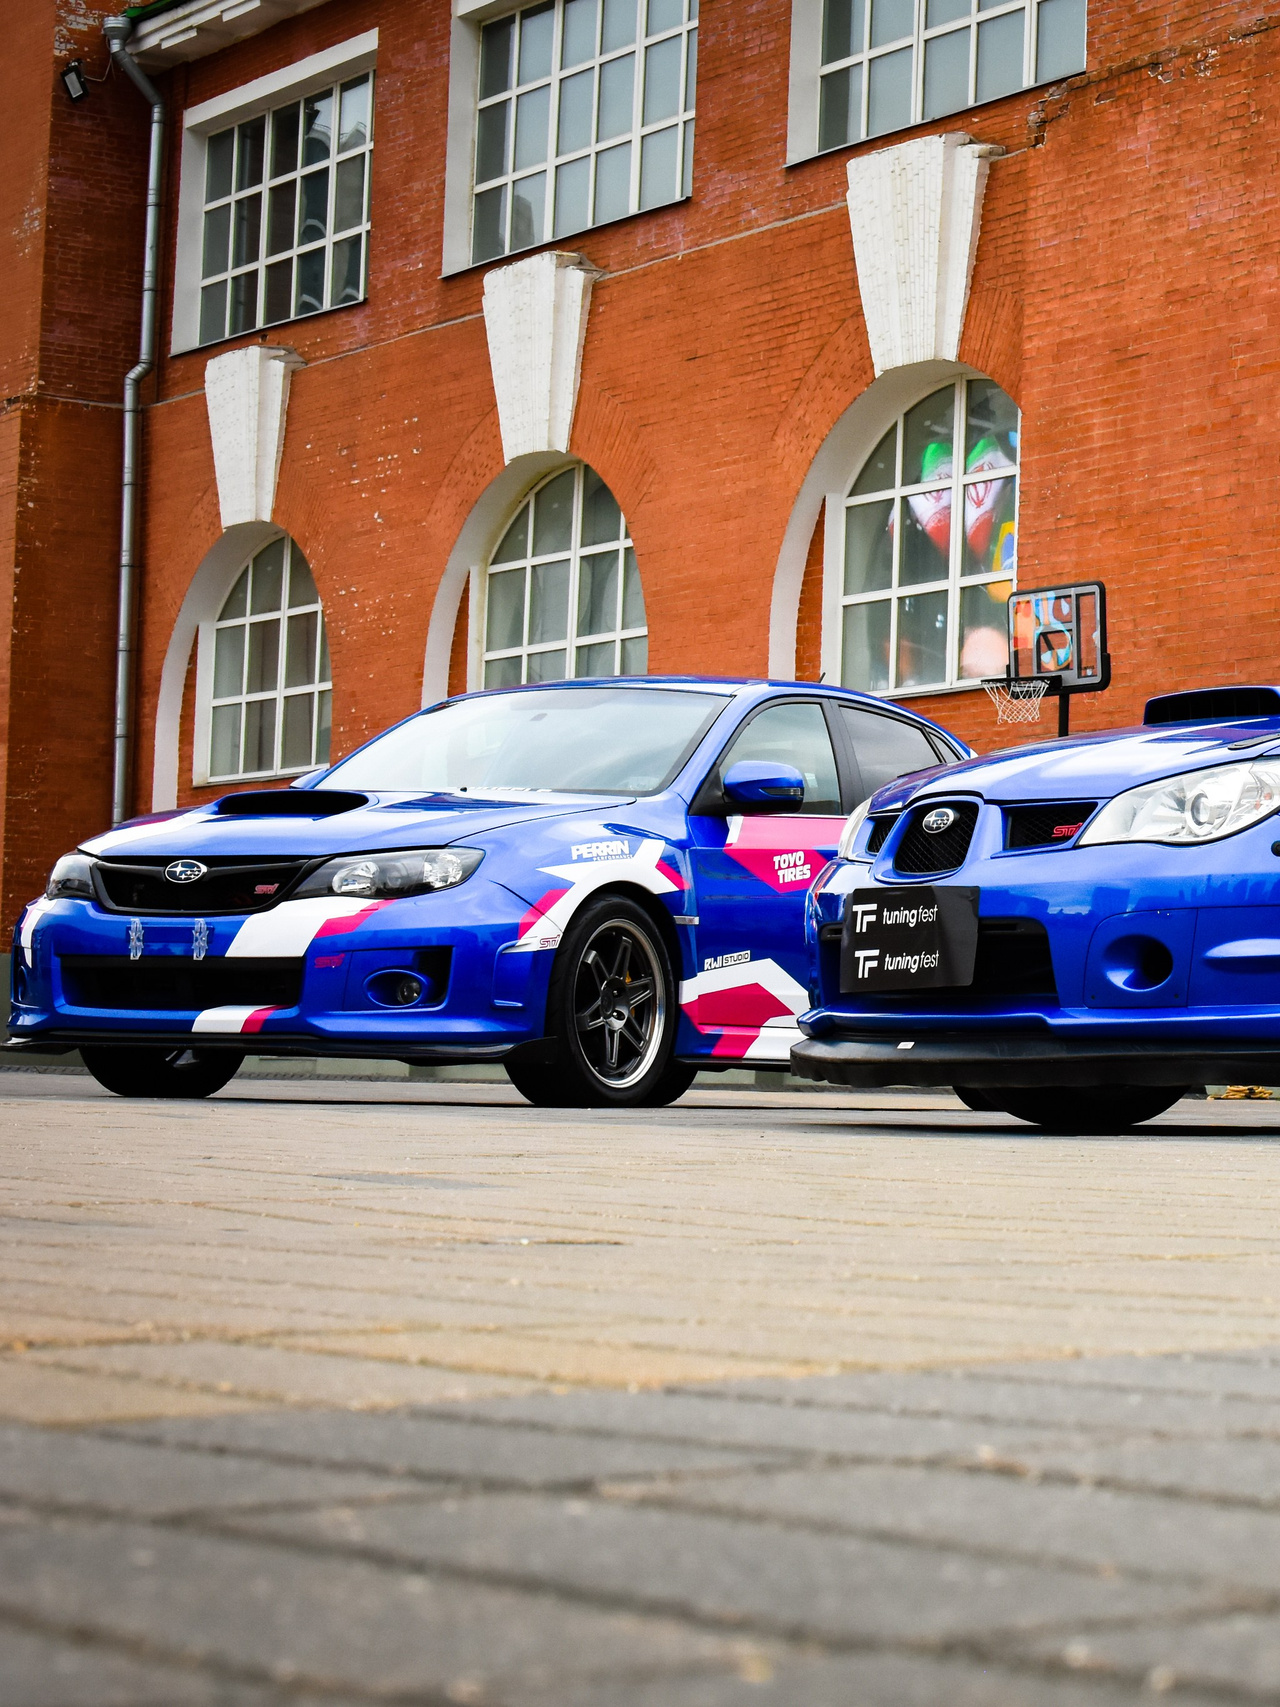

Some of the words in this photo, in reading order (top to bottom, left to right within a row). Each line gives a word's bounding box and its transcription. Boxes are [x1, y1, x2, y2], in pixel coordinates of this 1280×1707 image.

[571, 840, 630, 860] PERRIN
[773, 851, 805, 870] TOYO
[777, 864, 811, 884] TIRES
[724, 952, 749, 965] STUDIO
